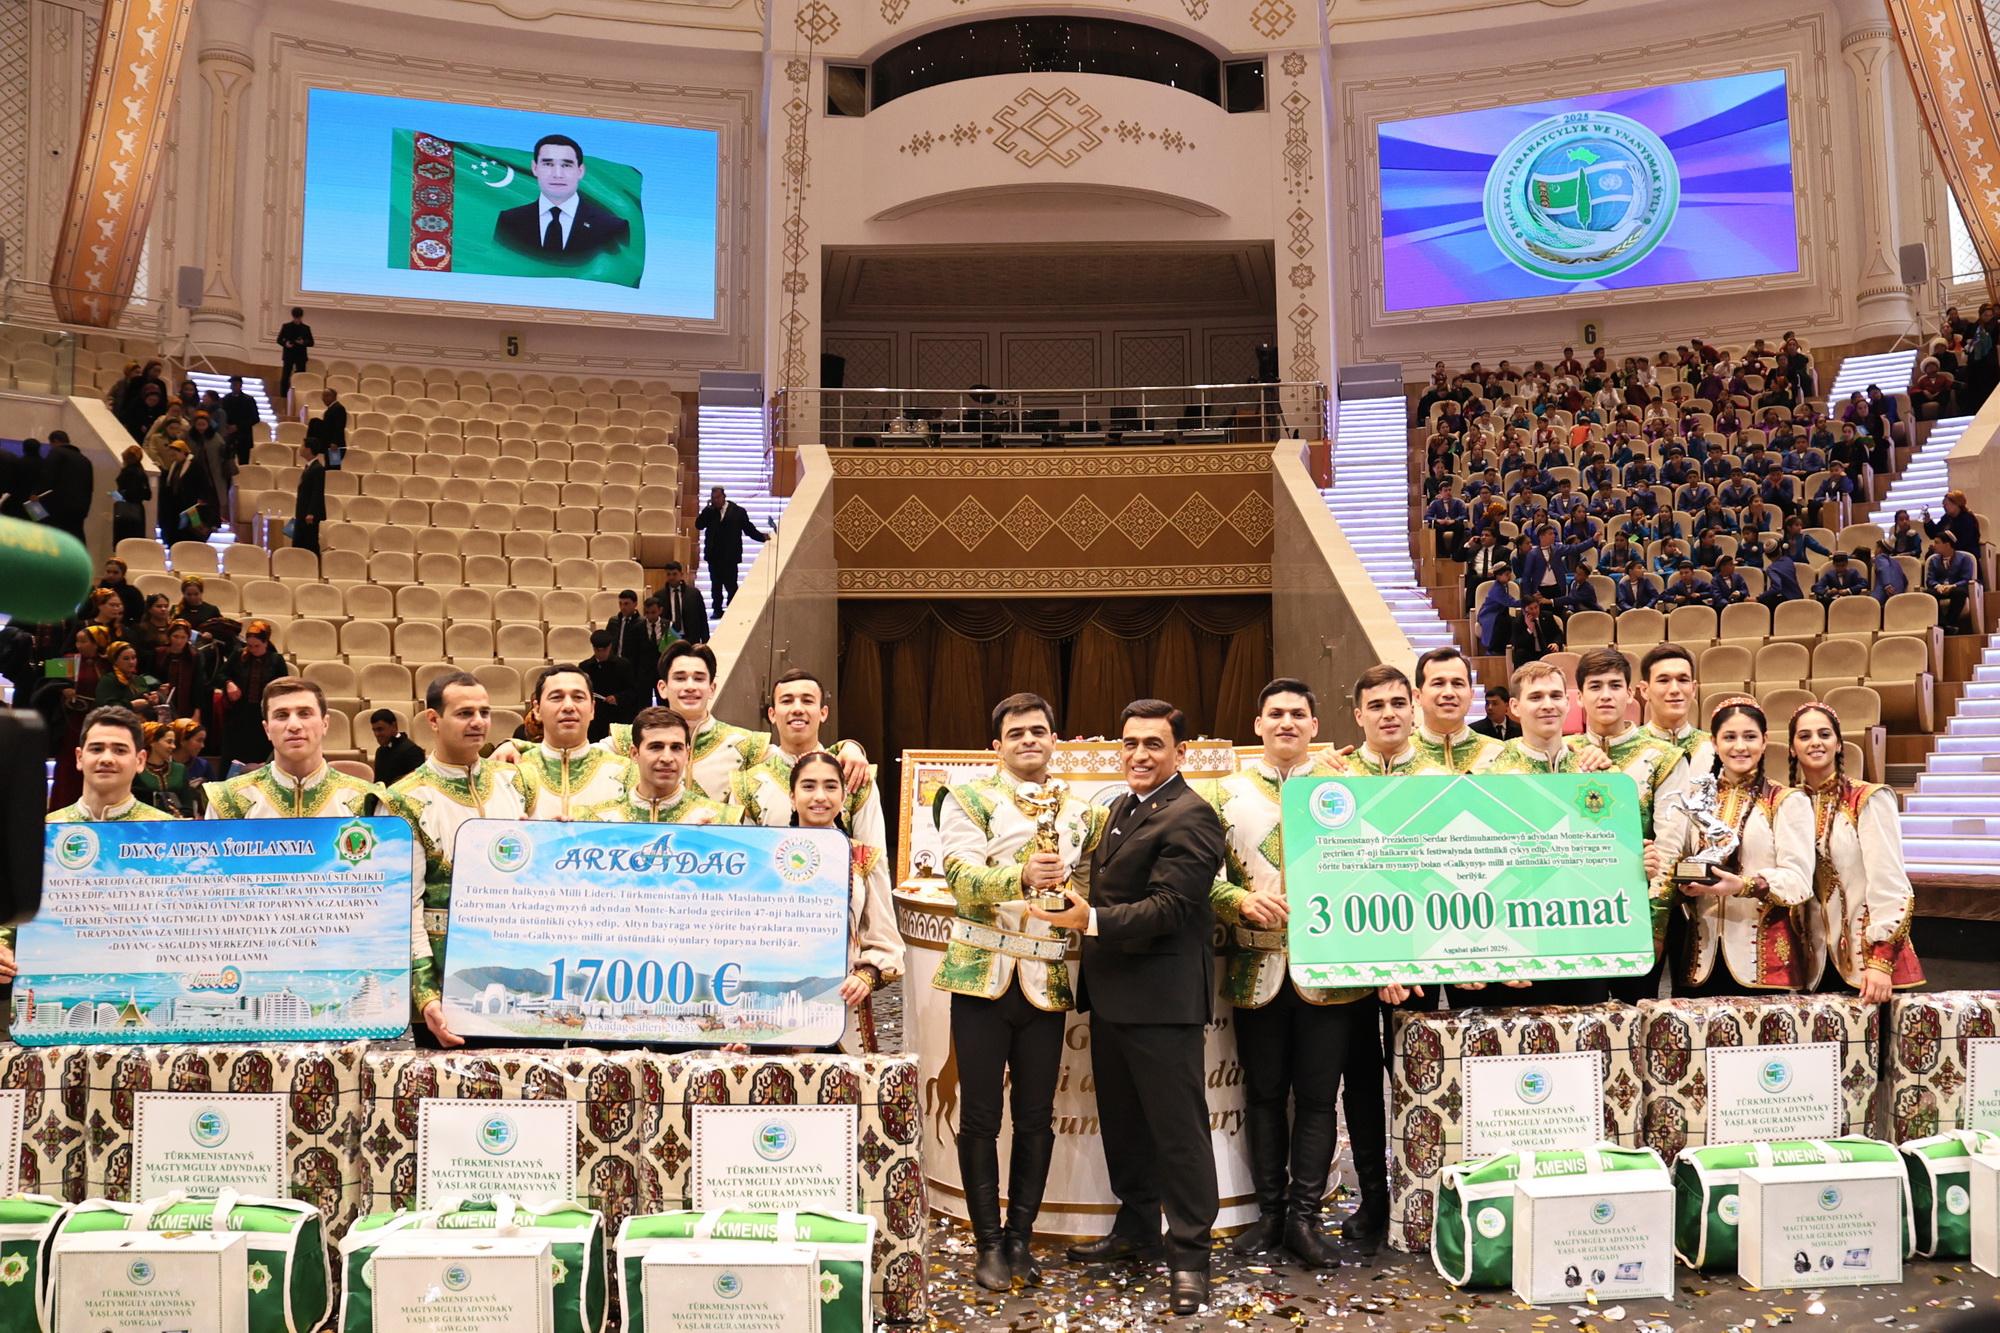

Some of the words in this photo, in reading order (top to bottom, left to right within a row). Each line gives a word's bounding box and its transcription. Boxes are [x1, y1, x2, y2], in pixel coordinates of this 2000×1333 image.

[1563, 113, 1589, 123] 2025
[1593, 124, 1611, 134] WE
[1510, 124, 1589, 177] PARAHATÇYLYK
[1614, 129, 1662, 184] YNANYŞMAK
[1503, 180, 1520, 230] HALKARA
[1649, 186, 1664, 215] ÝYLY
[1584, 323, 1597, 345] 6
[507, 336, 519, 357] 5
[120, 843, 164, 860] DYNÇ
[168, 842, 219, 859] ALYŞA
[223, 838, 315, 856] ÝOLLANMA
[49, 878, 130, 887] MONTE-KARLODA
[132, 876, 183, 887] GEÇIRILEN
[185, 875, 230, 884] HALKARA
[232, 875, 253, 883] SIRK
[255, 873, 326, 883] FESTIWALYNDA
[328, 871, 384, 881] ÜSTÜNLIKLI
[49, 891, 80, 901] ÇYKYŞ
[107, 889, 136, 898] ALTYN
[140, 886, 183, 898] BAÝRAGA
[185, 887, 199, 896] WE
[202, 884, 237, 896] ÝÖRITE
[239, 884, 302, 895] BAÝRAKLARA
[305, 885, 349, 894] MYNASYP
[351, 885, 383, 894] BOLAN
[465, 885, 509, 895] Türkmen
[512, 887, 556, 900] halkynyň
[559, 888, 581, 898] Milli
[620, 889, 698, 903] Türkmenistanyň
[701, 892, 725, 902] Halk
[728, 893, 795, 906] Maslahatynyň
[798, 895, 834, 907] Başlygy
[51, 903, 110, 915] «GALKYNYŞ»
[113, 903, 140, 912] MILLI
[142, 903, 153, 911] AT
[155, 899, 209, 910] ÜSTÜNDÄKI
[210, 898, 255, 909] OÝUNLAR
[258, 898, 313, 908] TOPARYNYŇ
[316, 899, 379, 908] AGZALARYNA
[455, 899, 506, 912] Gahryman
[509, 902, 587, 914] Arkadagymyzyň
[589, 904, 631, 915] adyndan
[634, 904, 708, 917] Monte-Karloda
[710, 908, 751, 920] geçirilen
[753, 909, 781, 921] 47-nji
[784, 910, 822, 920] halkara
[824, 911, 843, 920] sirk
[1309, 896, 1331, 934] 3
[1344, 894, 1414, 933] 000
[1426, 892, 1495, 931] 000
[1506, 890, 1630, 929] manat
[63, 913, 149, 926] TÜRKMENISTANYŇ
[151, 914, 218, 924] MAGTYMGULY
[220, 914, 270, 923] ADYNDAKY
[274, 910, 310, 923] ÝAŞLAR
[312, 912, 365, 921] GURAMASY
[76, 929, 140, 938] TARAPYNDAN
[141, 928, 172, 937] AWAZA
[174, 928, 201, 936] MILLI
[202, 926, 278, 937] SYÝAHATÇYLYK
[280, 925, 351, 934] ZOLAGYNDAKY
[458, 914, 517, 926] festiwalynda
[519, 917, 564, 926] üstünlikli
[567, 919, 594, 929] çykyş
[622, 919, 649, 931] Altyn
[651, 920, 691, 933] baýraga
[709, 922, 737, 933] ýörite
[739, 923, 793, 935] baýraklara
[796, 926, 838, 937] mynasyp
[108, 940, 156, 951] «DAÝANÇ»
[158, 941, 207, 951] SAGALDYŞ
[209, 939, 264, 949] MERKEZINE
[267, 939, 276, 948] 10
[278, 937, 318, 948] GÜNLÜK
[492, 929, 520, 939] bolan
[522, 930, 578, 943] «Galkynyş»
[581, 932, 603, 942] milli
[605, 933, 615, 942] at
[617, 933, 665, 944] üstündäki
[668, 934, 710, 947] oýunlary
[713, 937, 757, 949] toparyna
[156, 954, 182, 965] DYNÇ
[183, 953, 213, 964] ALYŞA
[215, 951, 268, 962] ÝOLLANMA
[549, 957, 694, 1005] 17000
[711, 962, 741, 1006] €
[1736, 1094, 1814, 1106] TÜRKMENISTANYŇ
[1492, 1105, 1575, 1117] TÜRKMENISTANYŇ
[1720, 1107, 1781, 1117] MAGTYMGULY
[1783, 1104, 1830, 1114] ADYNDAKY
[1475, 1118, 1541, 1128] MAGTYMGULY
[1543, 1115, 1591, 1125] ADYNDAKY
[1724, 1115, 1758, 1127] ÝAŞLAR
[1760, 1113, 1825, 1125] GURAMASYNYŇ
[1480, 1129, 1516, 1139] ÝAŞLAR
[1518, 1125, 1587, 1137] GURAMASYNYŇ
[1753, 1125, 1796, 1135] SOWGADY
[1511, 1137, 1557, 1147] SOWGADY
[164, 1150, 254, 1161] TÜRKMENISTANYŇ
[451, 1157, 543, 1168] TÜRKMENISTANYŇ
[146, 1163, 218, 1172] MAGTYMGULY
[219, 1163, 272, 1173] ADYNDAKY
[431, 1170, 504, 1179] MAGTYMGULY
[506, 1171, 562, 1180] ADYNDAKY
[726, 1164, 823, 1175] TÜRKMENISTANYŇ
[151, 1172, 190, 1184] ÝAŞLAR
[192, 1173, 267, 1183] GURAMASYNYŇ
[707, 1178, 782, 1187] MAGTYMGULY
[784, 1177, 842, 1186] ADYNDAKY
[437, 1180, 477, 1192] ÝAŞLAR
[480, 1180, 556, 1191] GURAMASYNYŇ
[712, 1188, 753, 1200] ÝAŞLAR
[756, 1187, 836, 1198] GURAMASYNYŇ
[748, 1200, 800, 1209] SOWGADY
